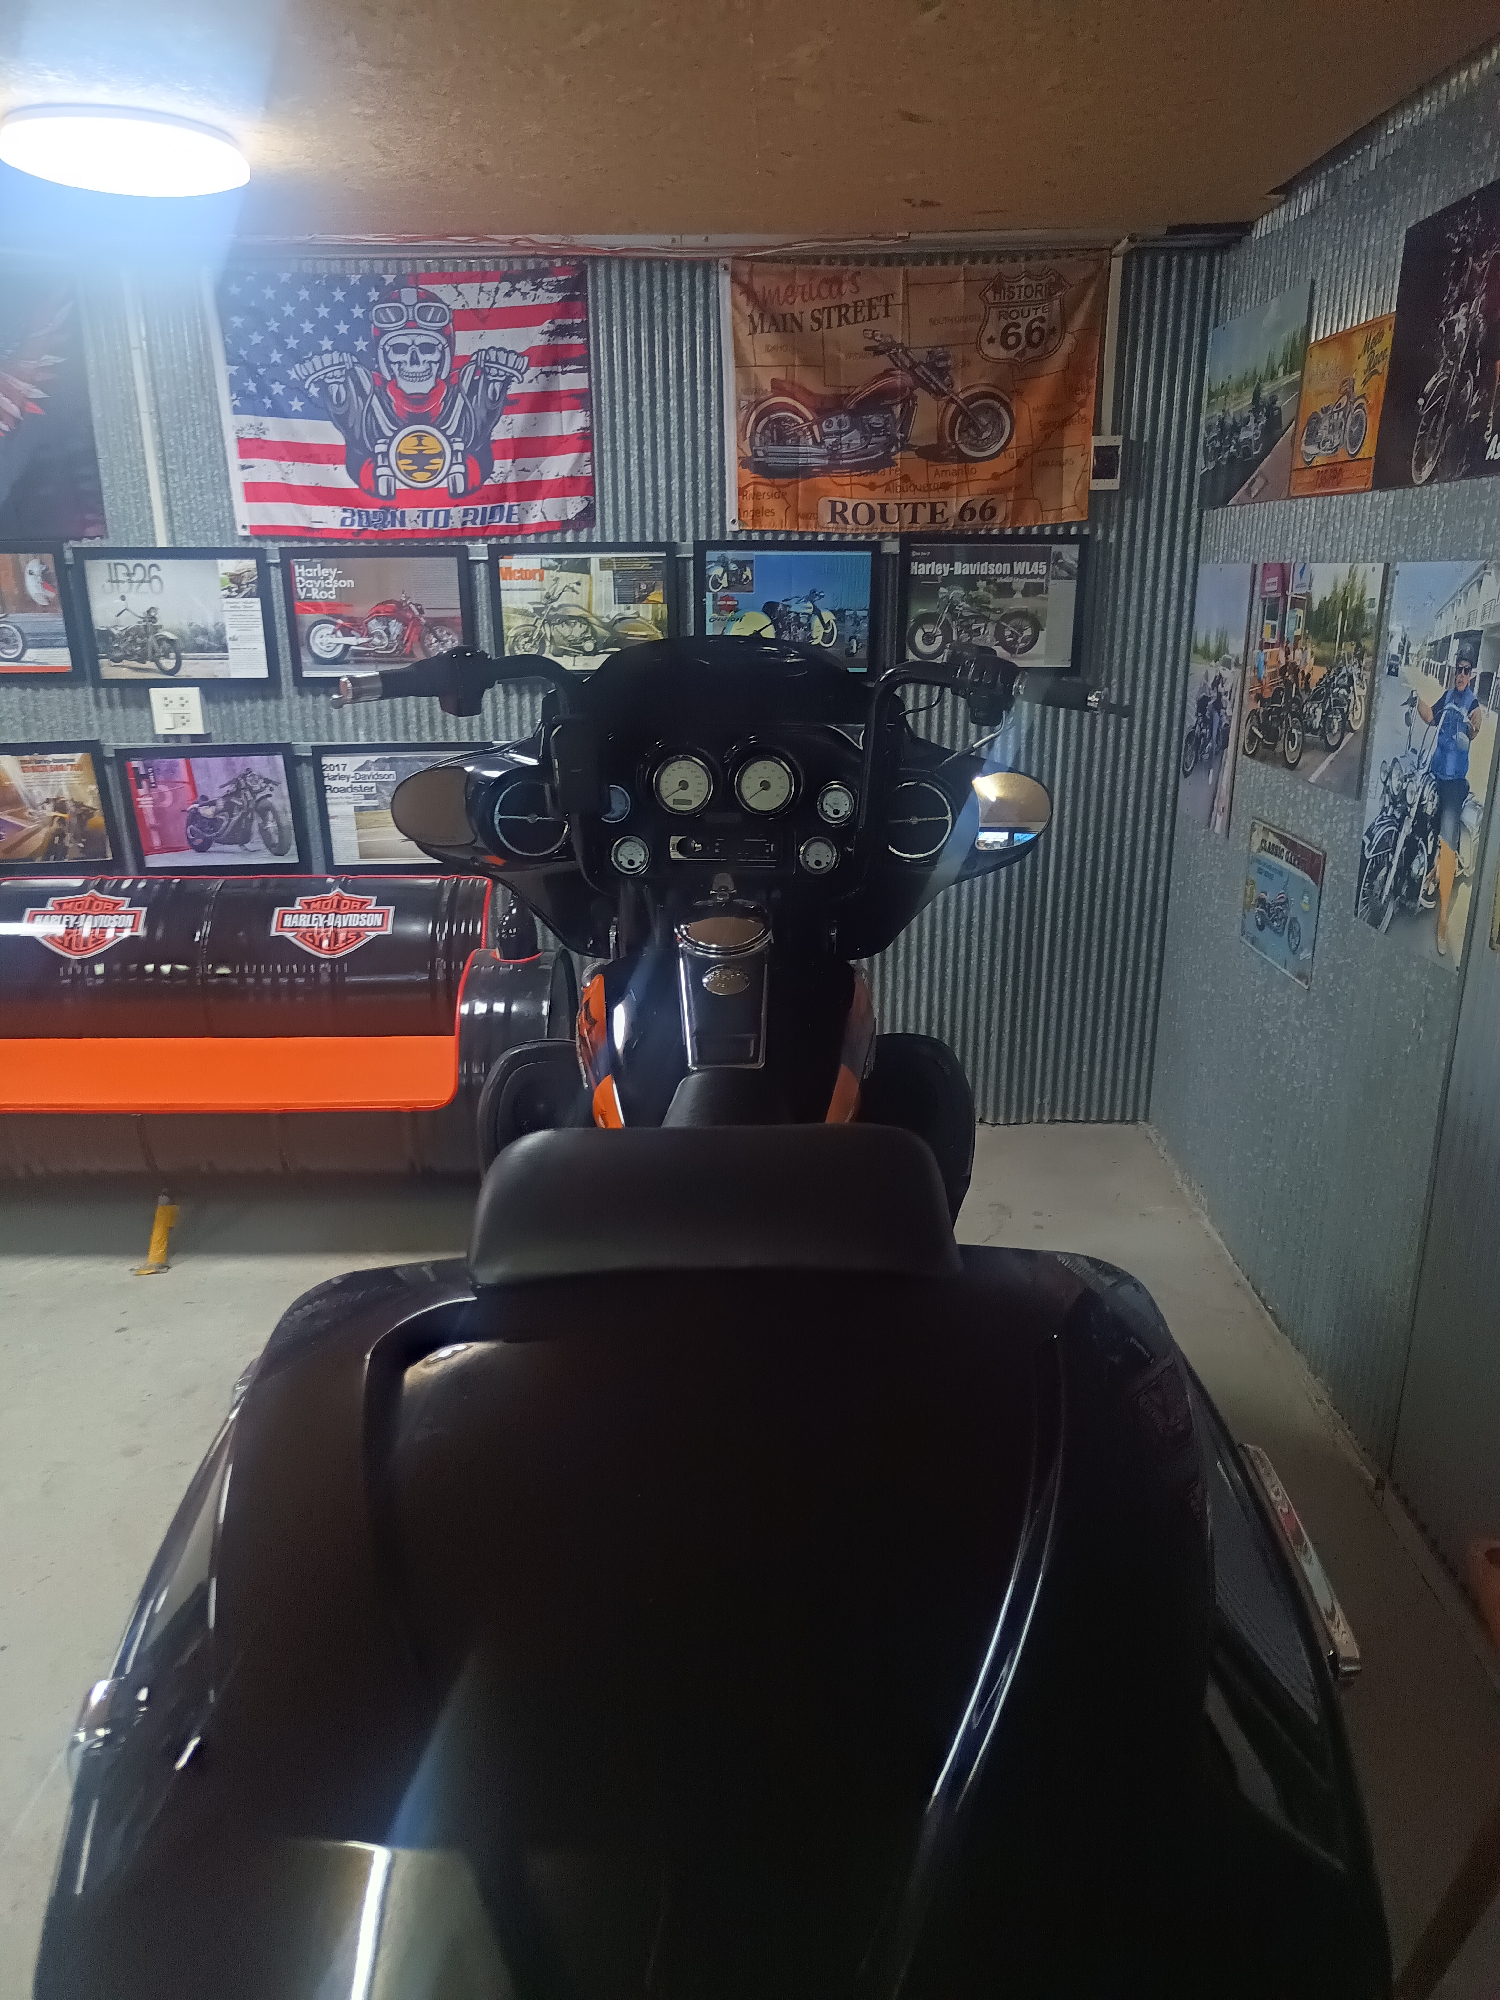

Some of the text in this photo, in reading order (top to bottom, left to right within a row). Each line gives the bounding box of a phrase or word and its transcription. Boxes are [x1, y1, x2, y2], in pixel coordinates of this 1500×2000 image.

[993, 281, 1057, 301] HISTORIC
[748, 293, 895, 336] MAIN STREET
[998, 305, 1050, 322] ROUTE
[1000, 315, 1047, 351] 66
[741, 489, 788, 501] Riverside
[884, 480, 953, 495] Albuquerq
[340, 502, 521, 530] BORN TO RIDE
[826, 497, 998, 526] ROUTE 66
[294, 563, 343, 581] Harley-
[499, 566, 546, 583] Victory
[910, 560, 1047, 577] Harley-Davidson WL45
[296, 577, 355, 588] Davidson
[297, 588, 336, 600] V-Rod
[323, 763, 347, 772] 2017
[323, 772, 396, 783] Harley-Davidson
[325, 784, 375, 794] Roadster
[62, 896, 113, 912] MOTOR
[310, 895, 362, 911] MOTOR
[282, 912, 383, 929] HARLEY-DAVIDSON
[304, 930, 359, 950] CYCLES
